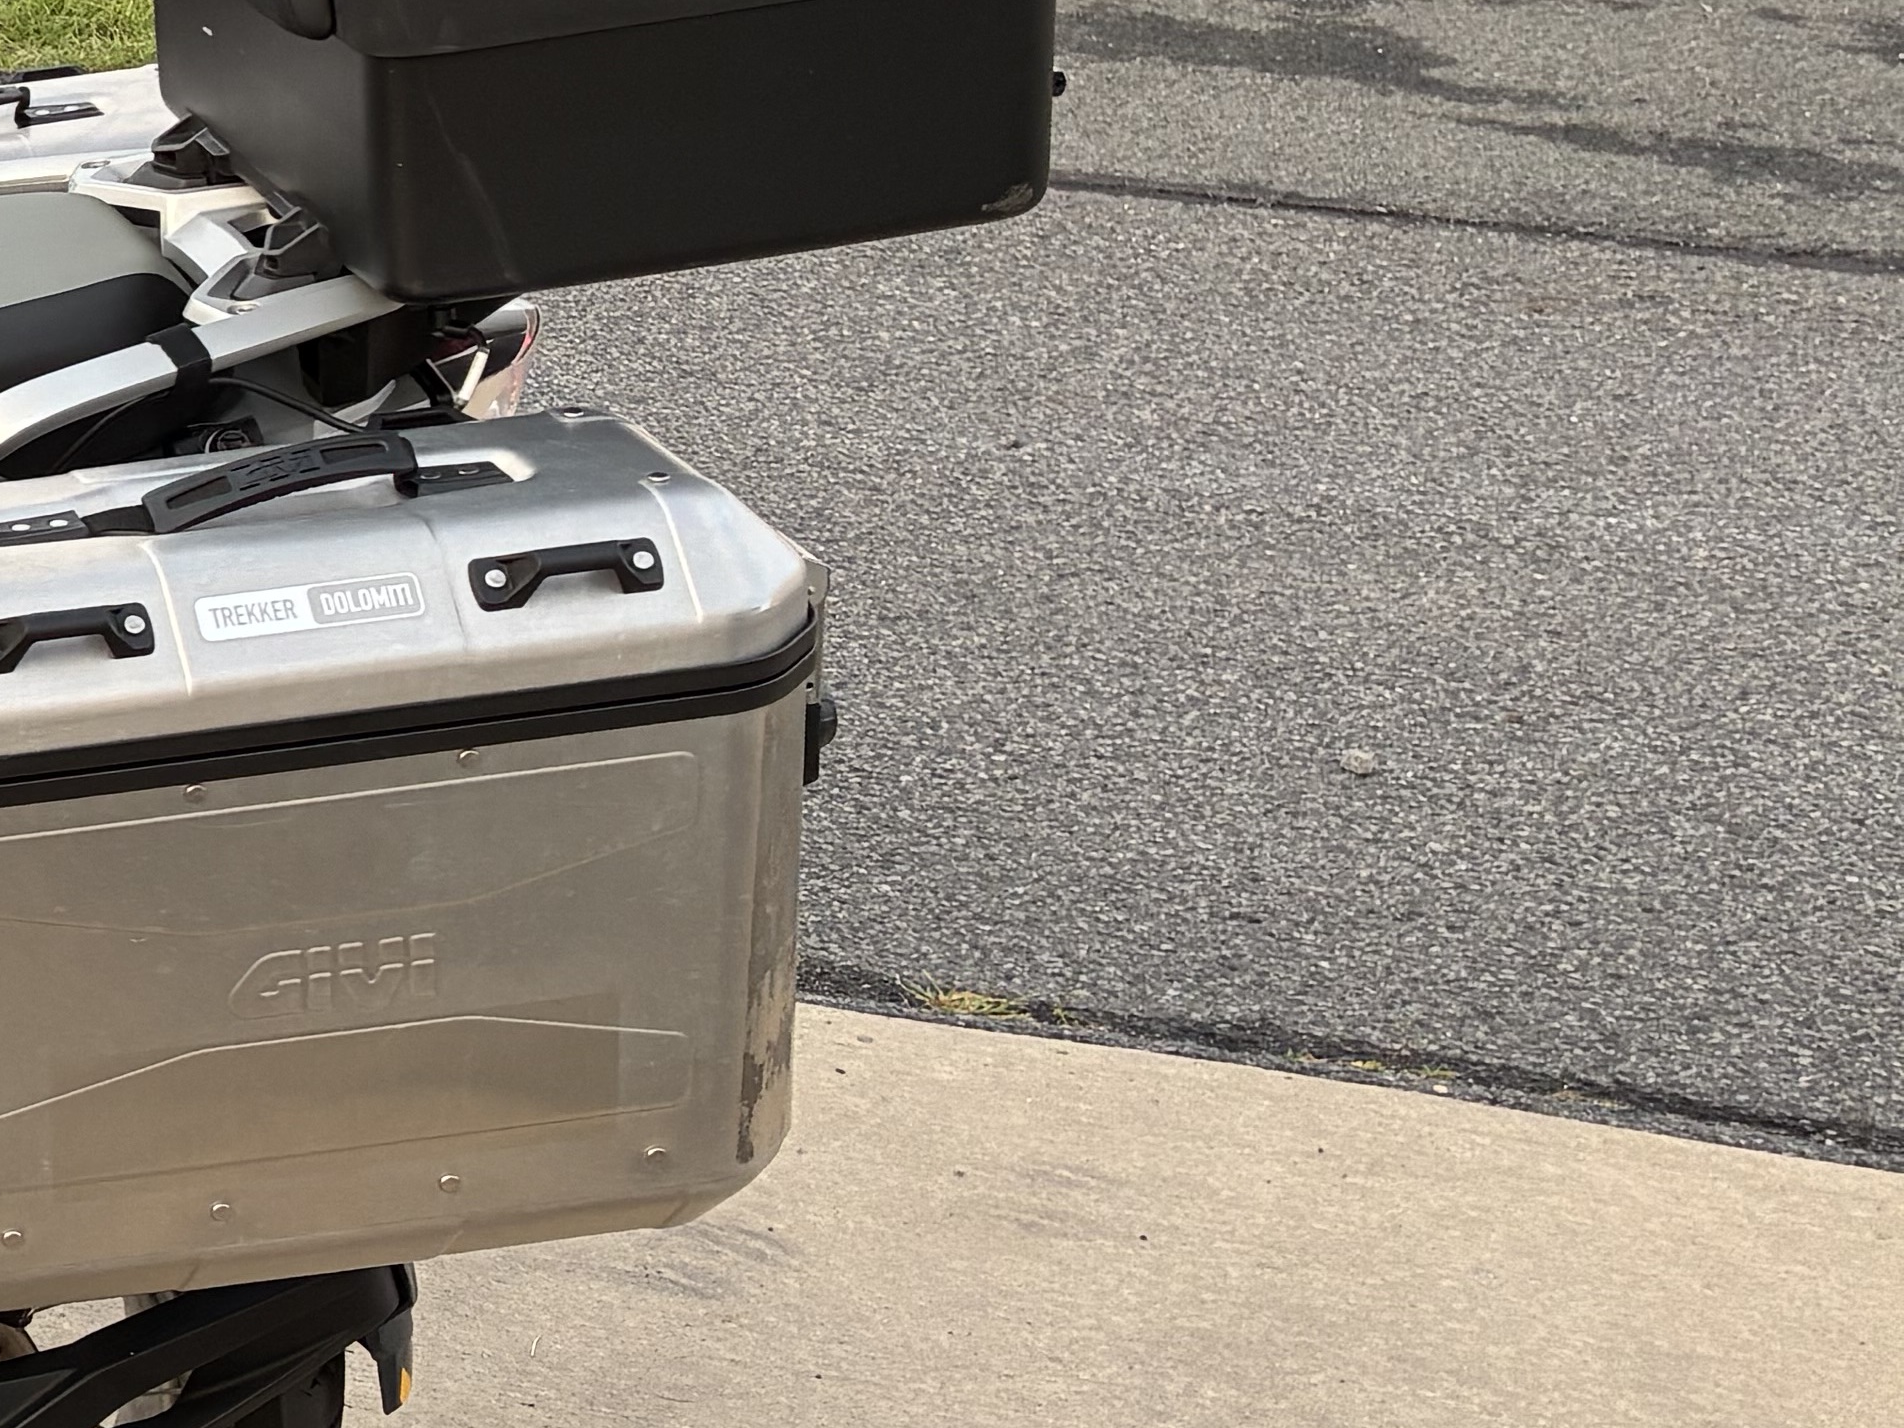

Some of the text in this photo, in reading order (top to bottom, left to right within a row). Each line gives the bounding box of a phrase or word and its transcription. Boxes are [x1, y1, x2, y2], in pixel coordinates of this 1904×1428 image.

[208, 583, 414, 629] TREKKER DOLOMITI
[229, 932, 436, 1019] GIVI
